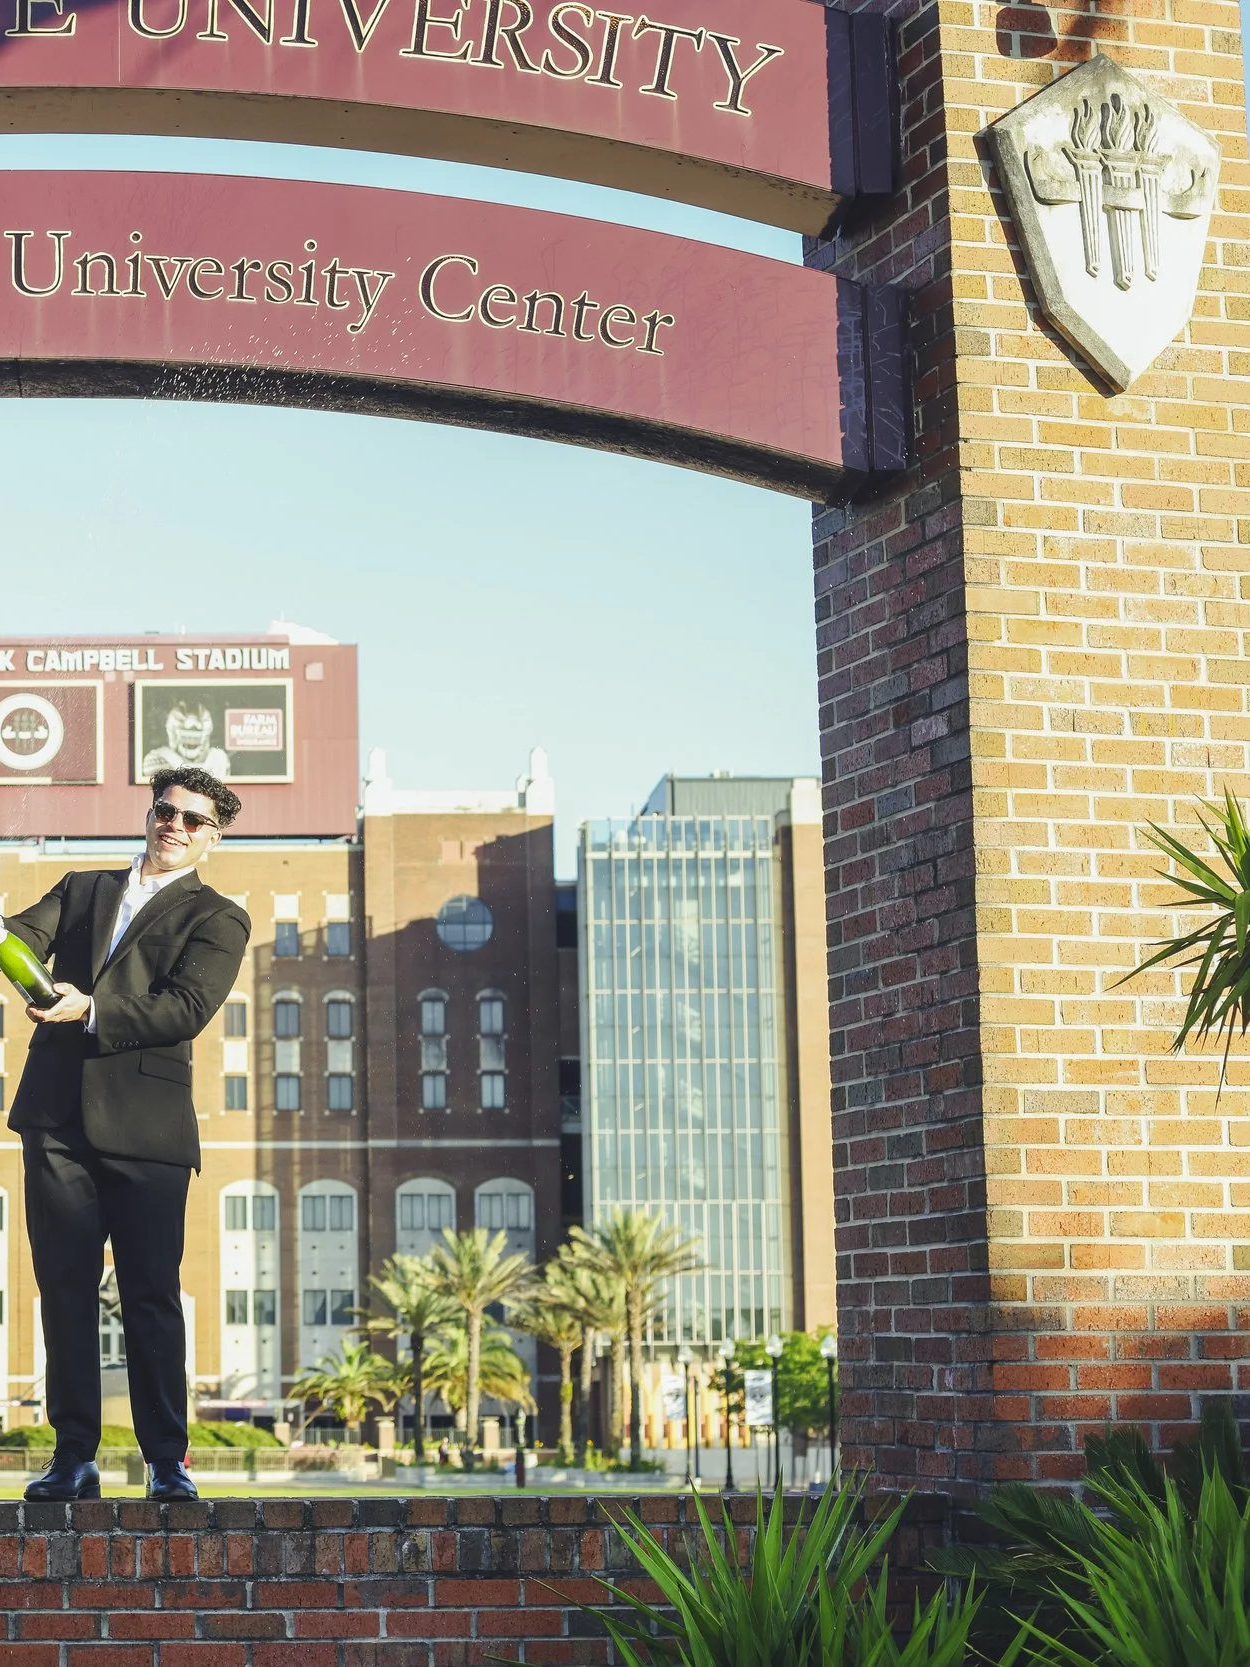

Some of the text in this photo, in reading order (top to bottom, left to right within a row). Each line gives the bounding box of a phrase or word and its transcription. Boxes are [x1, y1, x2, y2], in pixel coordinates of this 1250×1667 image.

[126, 0, 784, 117] UNIVERSITY
[4, 230, 394, 333] University
[418, 254, 675, 355] Center
[27, 649, 164, 672] CAMPBELL
[176, 647, 290, 671] STADIUM
